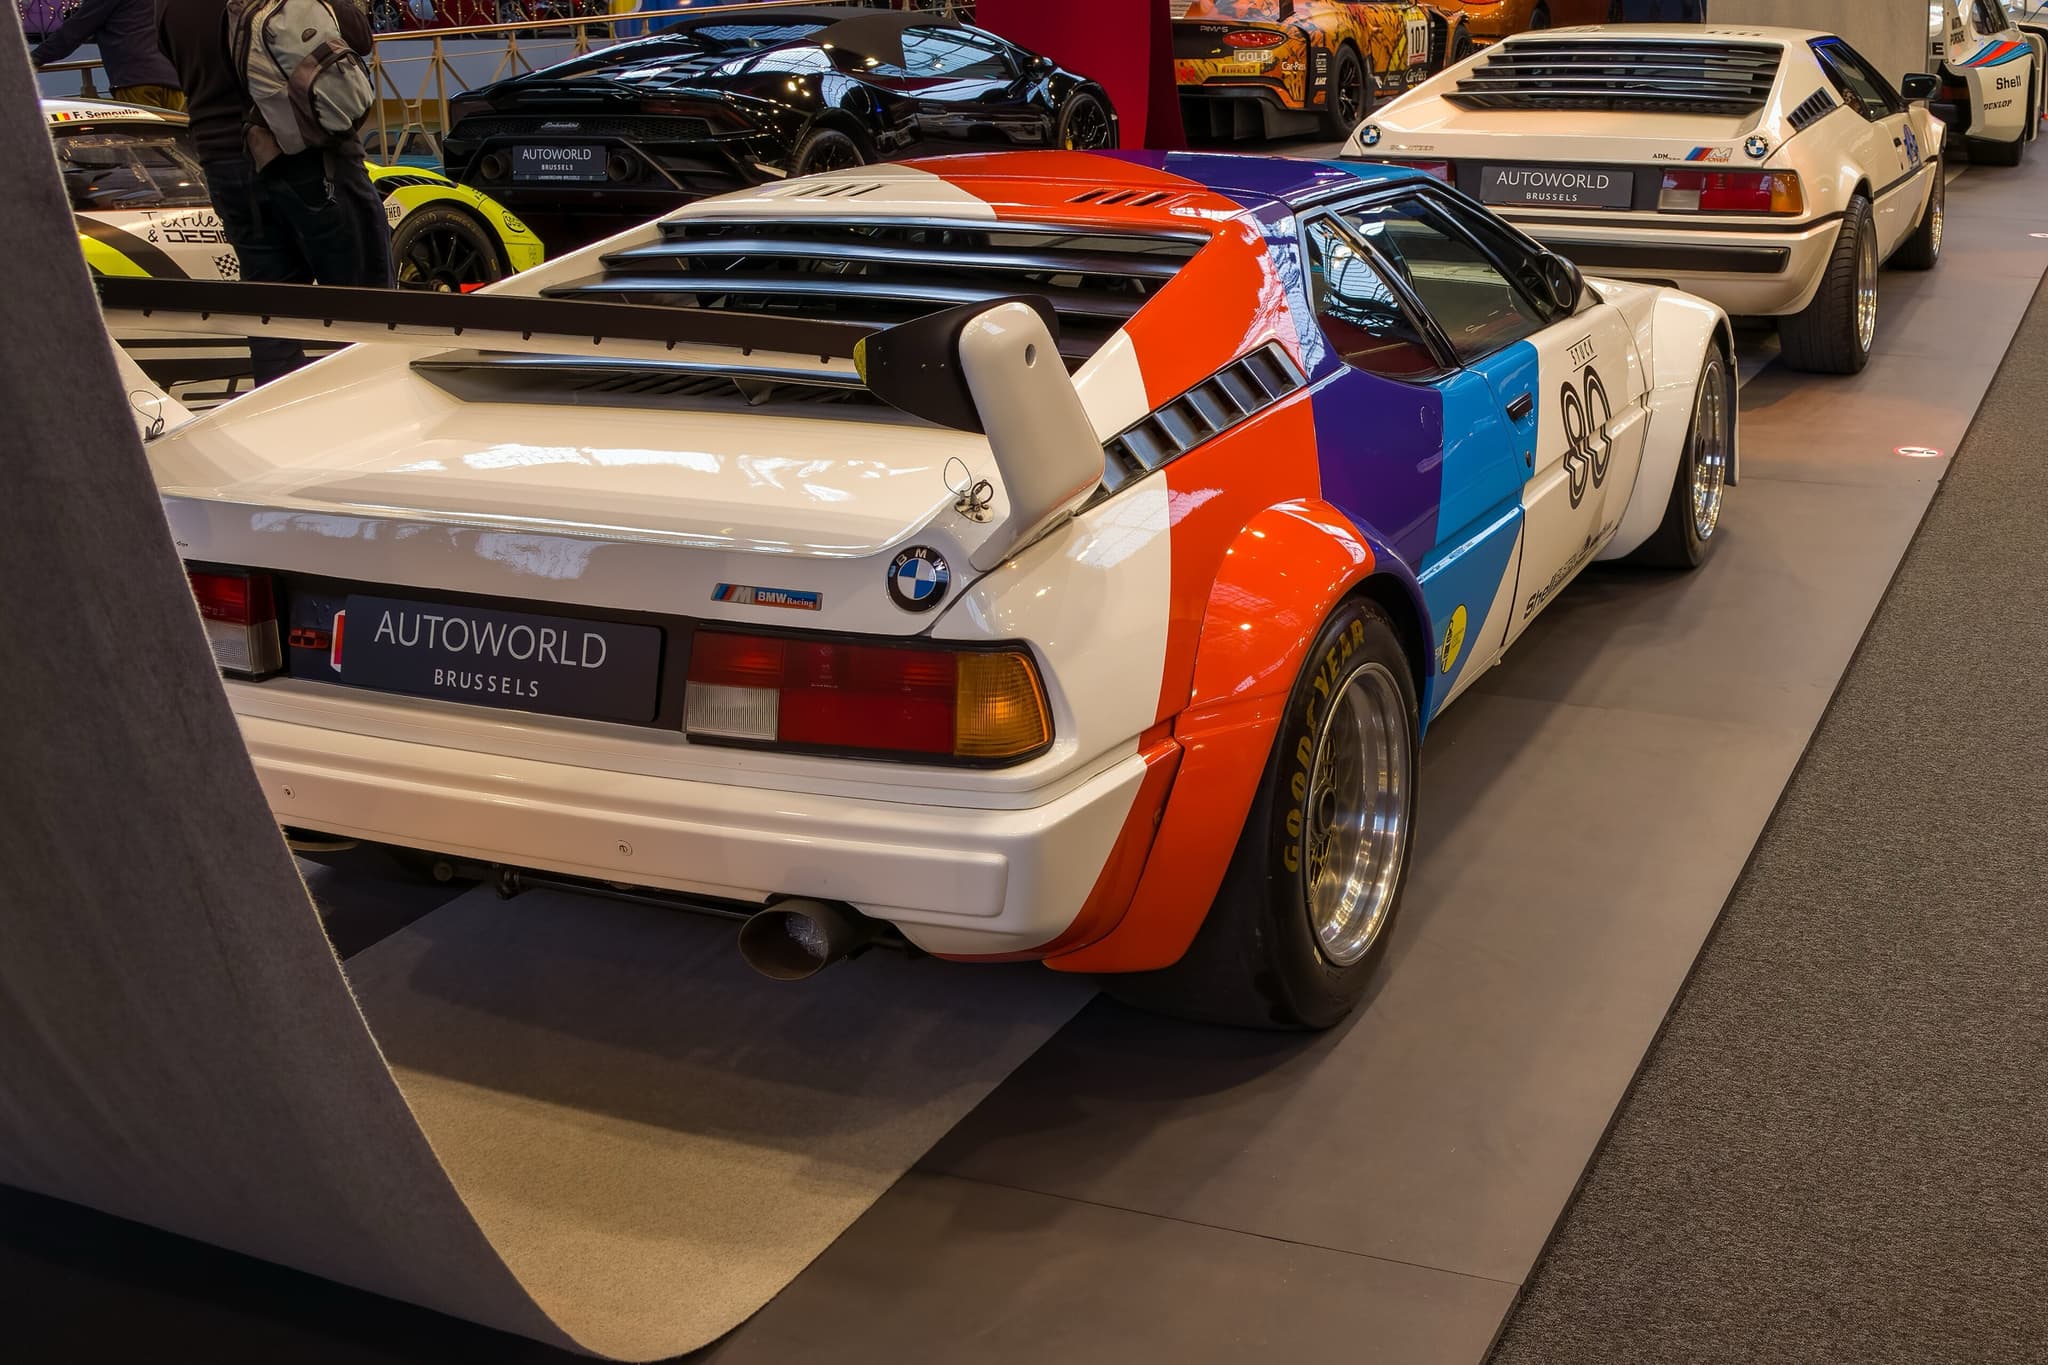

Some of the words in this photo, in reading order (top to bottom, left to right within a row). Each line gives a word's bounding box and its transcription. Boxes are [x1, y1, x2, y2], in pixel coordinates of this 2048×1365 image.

[1411, 26, 1426, 54] 107
[1238, 52, 1269, 62] GOLD
[1996, 75, 2022, 91] Shell
[1983, 100, 2013, 111] DUNLOP
[72, 111, 83, 119] F.
[522, 148, 592, 160] AUTOWORLD
[1497, 172, 1609, 189] AUTOWORLD
[1526, 192, 1578, 202] BRUSSELS
[148, 229, 159, 242] &
[1570, 339, 1596, 366] STUCK
[1560, 364, 1612, 510] 80
[757, 591, 787, 604] BMW
[787, 597, 814, 609] Racing
[374, 610, 607, 669] AUTOWORLD
[434, 668, 540, 698] BRUSSELS
